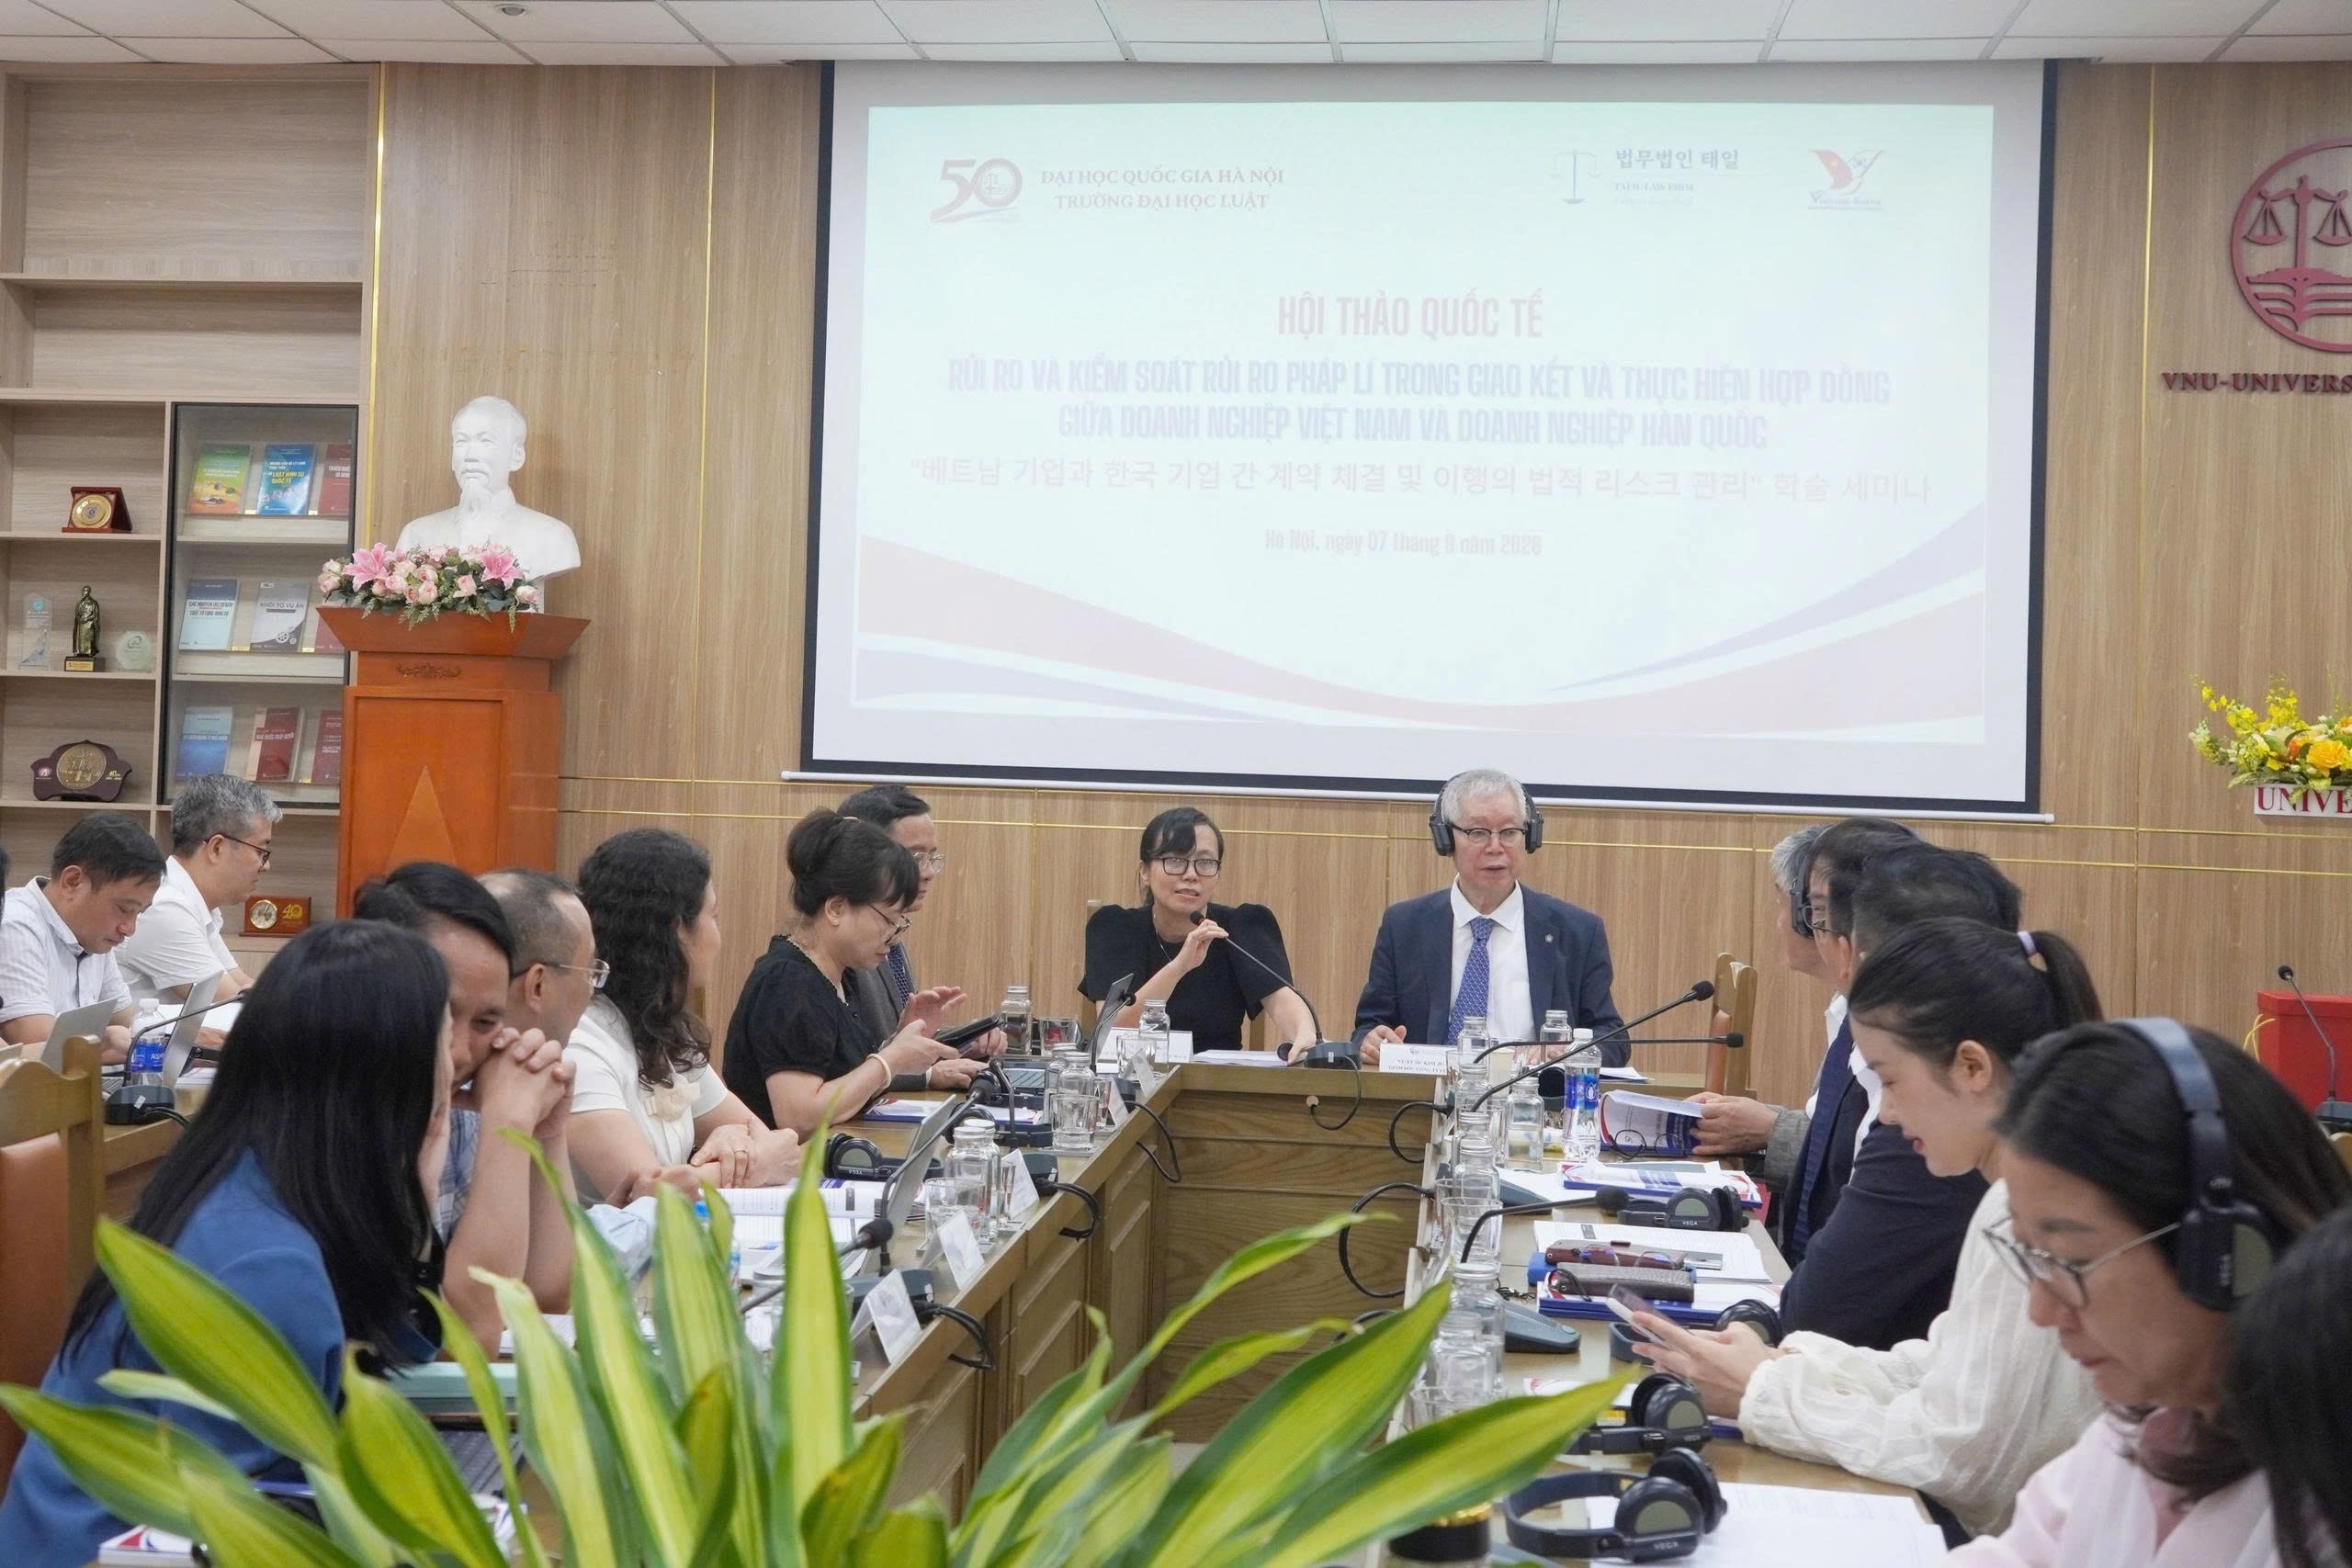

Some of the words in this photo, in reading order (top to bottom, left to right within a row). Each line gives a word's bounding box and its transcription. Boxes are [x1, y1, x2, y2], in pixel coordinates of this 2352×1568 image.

[1616, 148, 1693, 170] 법무법인
[1701, 149, 1739, 170] 태일
[1041, 169, 1073, 186] ĐẠI
[1078, 169, 1117, 187] HỌC
[1123, 164, 1176, 186] QUỐC
[1180, 168, 1213, 185] GIA
[1218, 164, 1247, 185] HÀ
[1250, 164, 1285, 187] NỘI
[1054, 191, 1133, 209] TRƯỜNG
[1137, 195, 1170, 211] ĐẠI
[1175, 194, 1216, 211] HỌC
[1221, 191, 1271, 211] LUẬT
[1278, 291, 1325, 341] HỘI
[1336, 289, 1410, 337] THẢO
[1420, 287, 1499, 341] QUỐC
[1510, 288, 1544, 338] TẾ
[948, 353, 986, 392] RỦI
[993, 358, 1024, 392] RO
[1031, 354, 1061, 392] VÀ
[1068, 351, 1129, 393] KIỂM
[1134, 354, 1197, 394] SOÁT
[1203, 353, 1240, 394] RỦI
[1248, 362, 1279, 394] RO
[1286, 356, 1347, 395] PHÁP
[1382, 362, 1460, 397] TRONG
[1467, 362, 1521, 398] GIAO
[1530, 355, 1574, 399] KẾT
[1581, 361, 1613, 400] VÀ
[1622, 366, 1689, 403] THỰC
[1694, 364, 1750, 404] HIỆN
[1758, 367, 1813, 406] HỢP
[1820, 361, 1891, 404] ĐỒNG
[2161, 372, 2352, 394] VNU-UNIVERS
[1058, 400, 1114, 438] GIỮA
[1120, 404, 1200, 439] DOANH
[1206, 401, 1292, 445] NGHIỆP
[1296, 401, 1348, 446] VIỆT
[1353, 407, 1411, 442] NAM
[1419, 404, 1451, 442] VÀ
[1457, 408, 1541, 445] DOANH
[1547, 408, 1634, 450] NGHIỆP
[1641, 406, 1691, 447] HÀN
[1700, 406, 1769, 450] QUỐC
[1012, 457, 1094, 488] 기업과
[1103, 459, 1158, 490] 한국
[1167, 460, 1220, 491] 기업
[1231, 461, 1259, 491] 간
[1266, 461, 1322, 492] 계약
[1330, 462, 1385, 493] 체결
[1396, 463, 1425, 493] 및
[1433, 463, 1516, 496] 이행의
[1529, 467, 1584, 496] 법적
[1594, 468, 1682, 499] 리스크
[1773, 472, 1831, 502] 학술
[1841, 473, 1932, 503] 세미나
[1264, 529, 1284, 549] Hà
[1325, 531, 1364, 556] ngày
[1367, 531, 1388, 551] 07
[1393, 532, 1441, 556] tháng
[1460, 535, 1496, 555] năm
